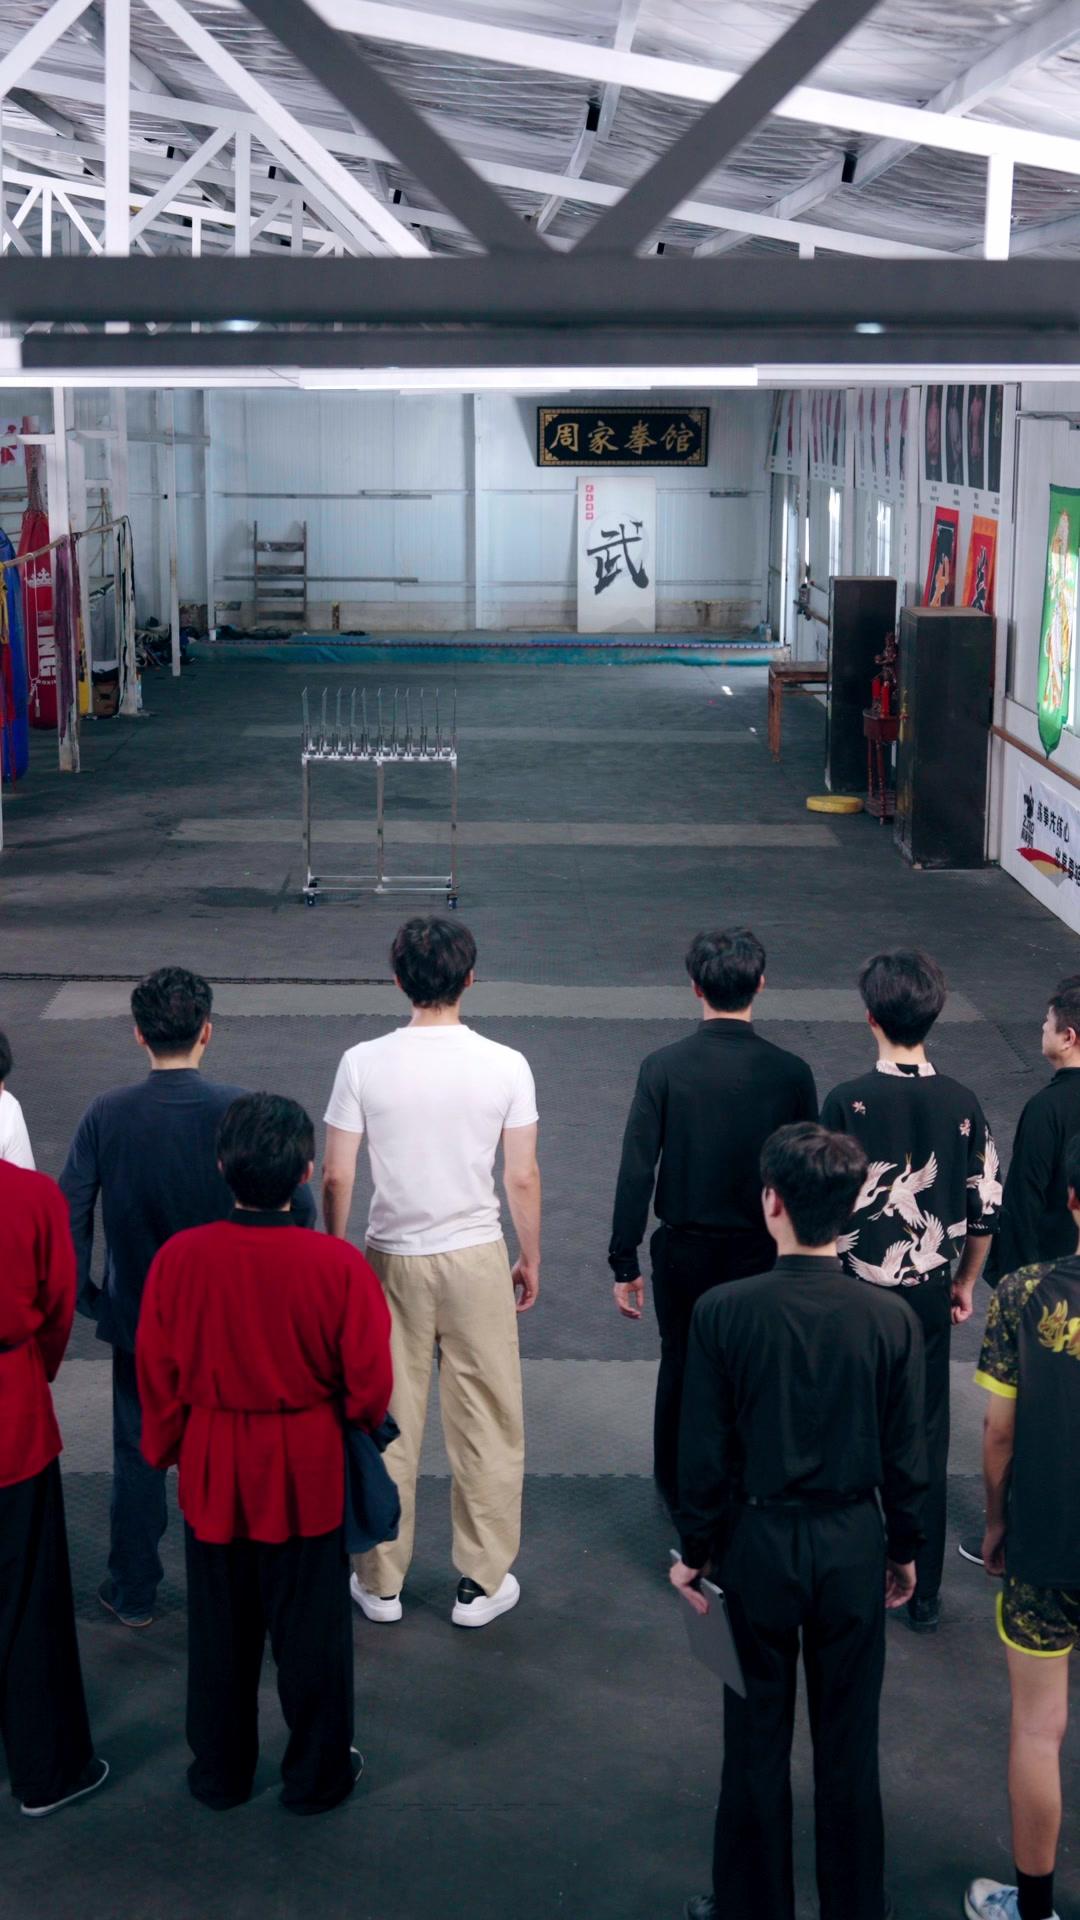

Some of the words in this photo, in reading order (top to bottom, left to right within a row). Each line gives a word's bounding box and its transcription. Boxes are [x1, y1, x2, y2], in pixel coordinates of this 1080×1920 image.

[549, 421, 695, 455] 周家拳馆
[586, 521, 649, 596] 武
